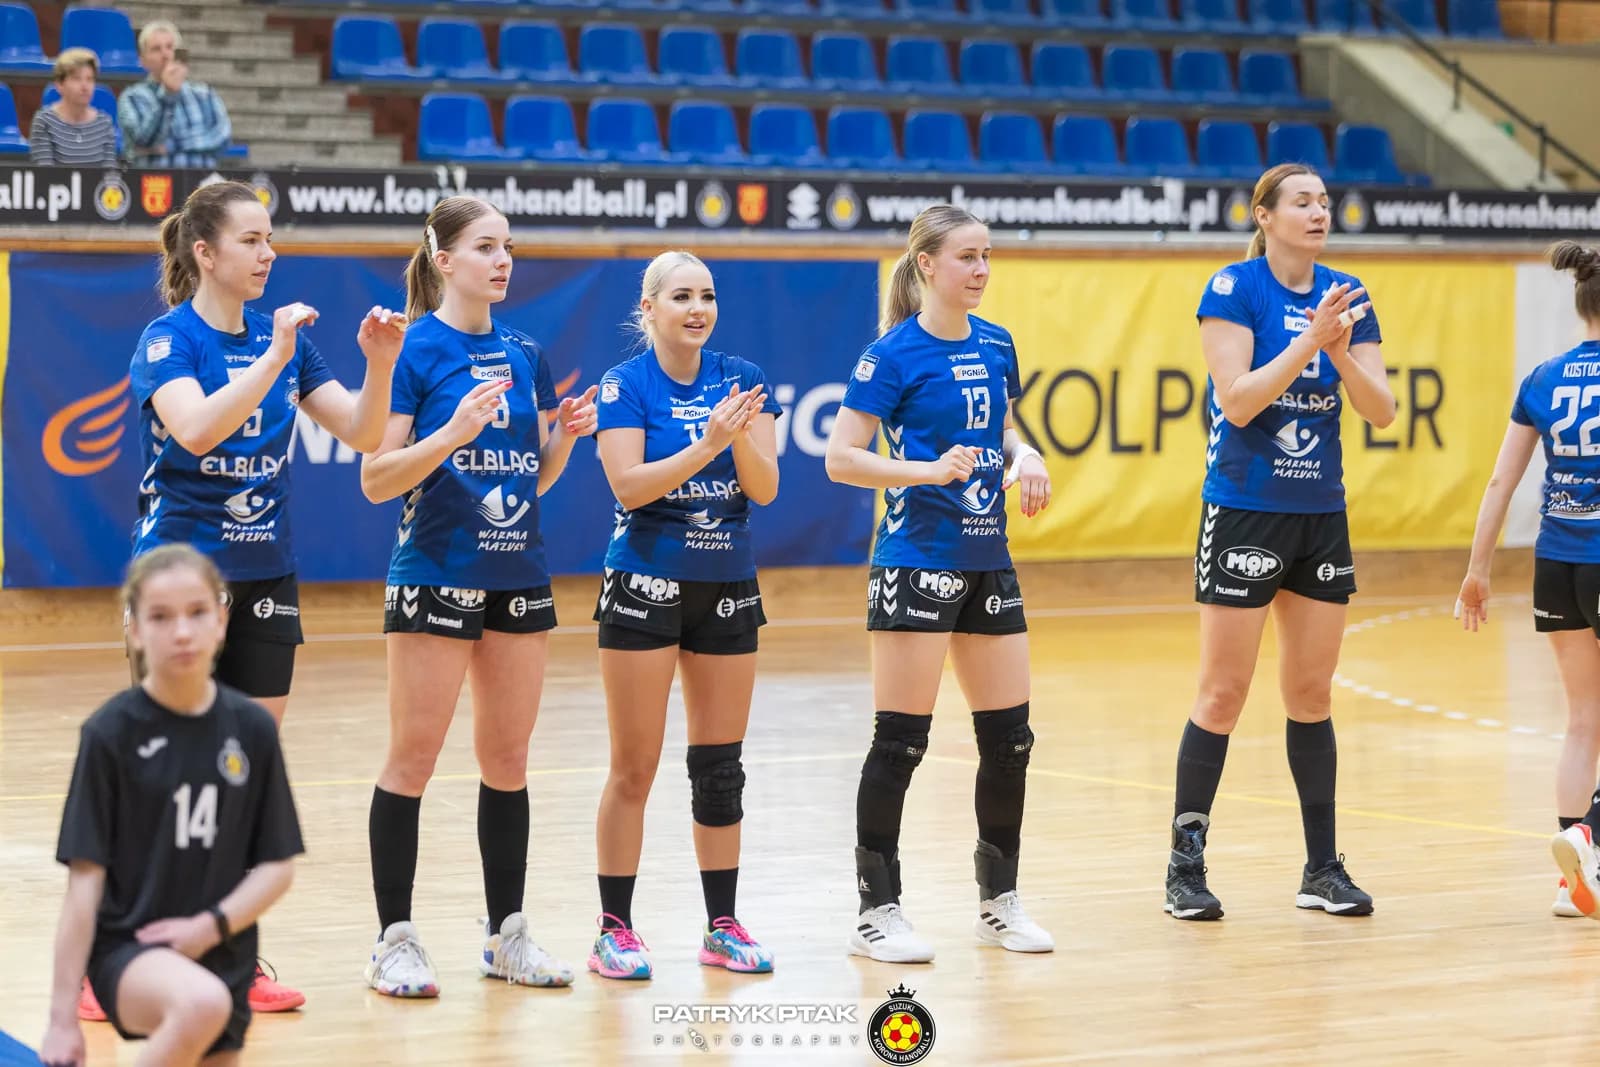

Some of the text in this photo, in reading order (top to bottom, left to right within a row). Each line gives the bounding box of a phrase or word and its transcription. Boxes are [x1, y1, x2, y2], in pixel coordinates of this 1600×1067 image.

[961, 386, 991, 430] 13
[1550, 384, 1600, 457] 22
[478, 529, 528, 540] WARMIA
[685, 530, 731, 540] WARMIA
[1226, 552, 1277, 573] MOP
[919, 572, 964, 595] MOP
[612, 602, 648, 619] hummel
[907, 606, 939, 621] hummel
[427, 613, 463, 629] hummel
[173, 783, 218, 849] 14
